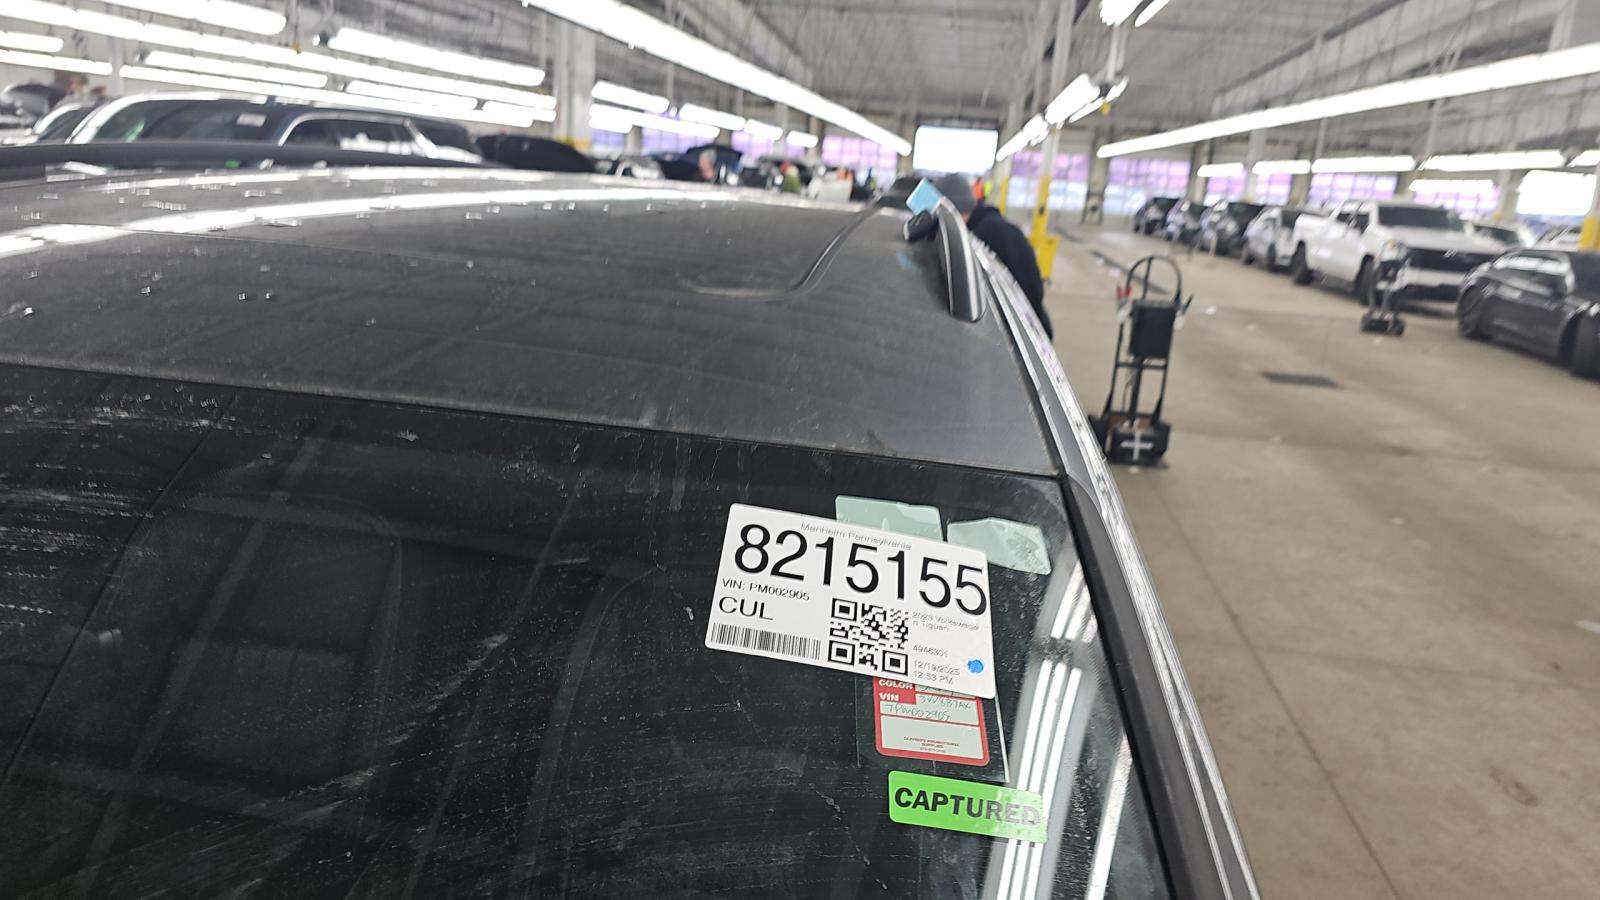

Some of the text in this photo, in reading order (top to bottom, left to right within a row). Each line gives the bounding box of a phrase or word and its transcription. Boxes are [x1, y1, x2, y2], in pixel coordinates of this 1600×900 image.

[801, 522, 912, 550] Manheim Pennsylvania
[734, 524, 987, 616] 8215155
[722, 578, 810, 601] VIN: PM002905
[719, 597, 773, 620] CUL
[879, 679, 914, 690] COLOR
[939, 676, 954, 685] PM
[879, 692, 899, 701] VIN
[894, 787, 1041, 827] CAPTURED
